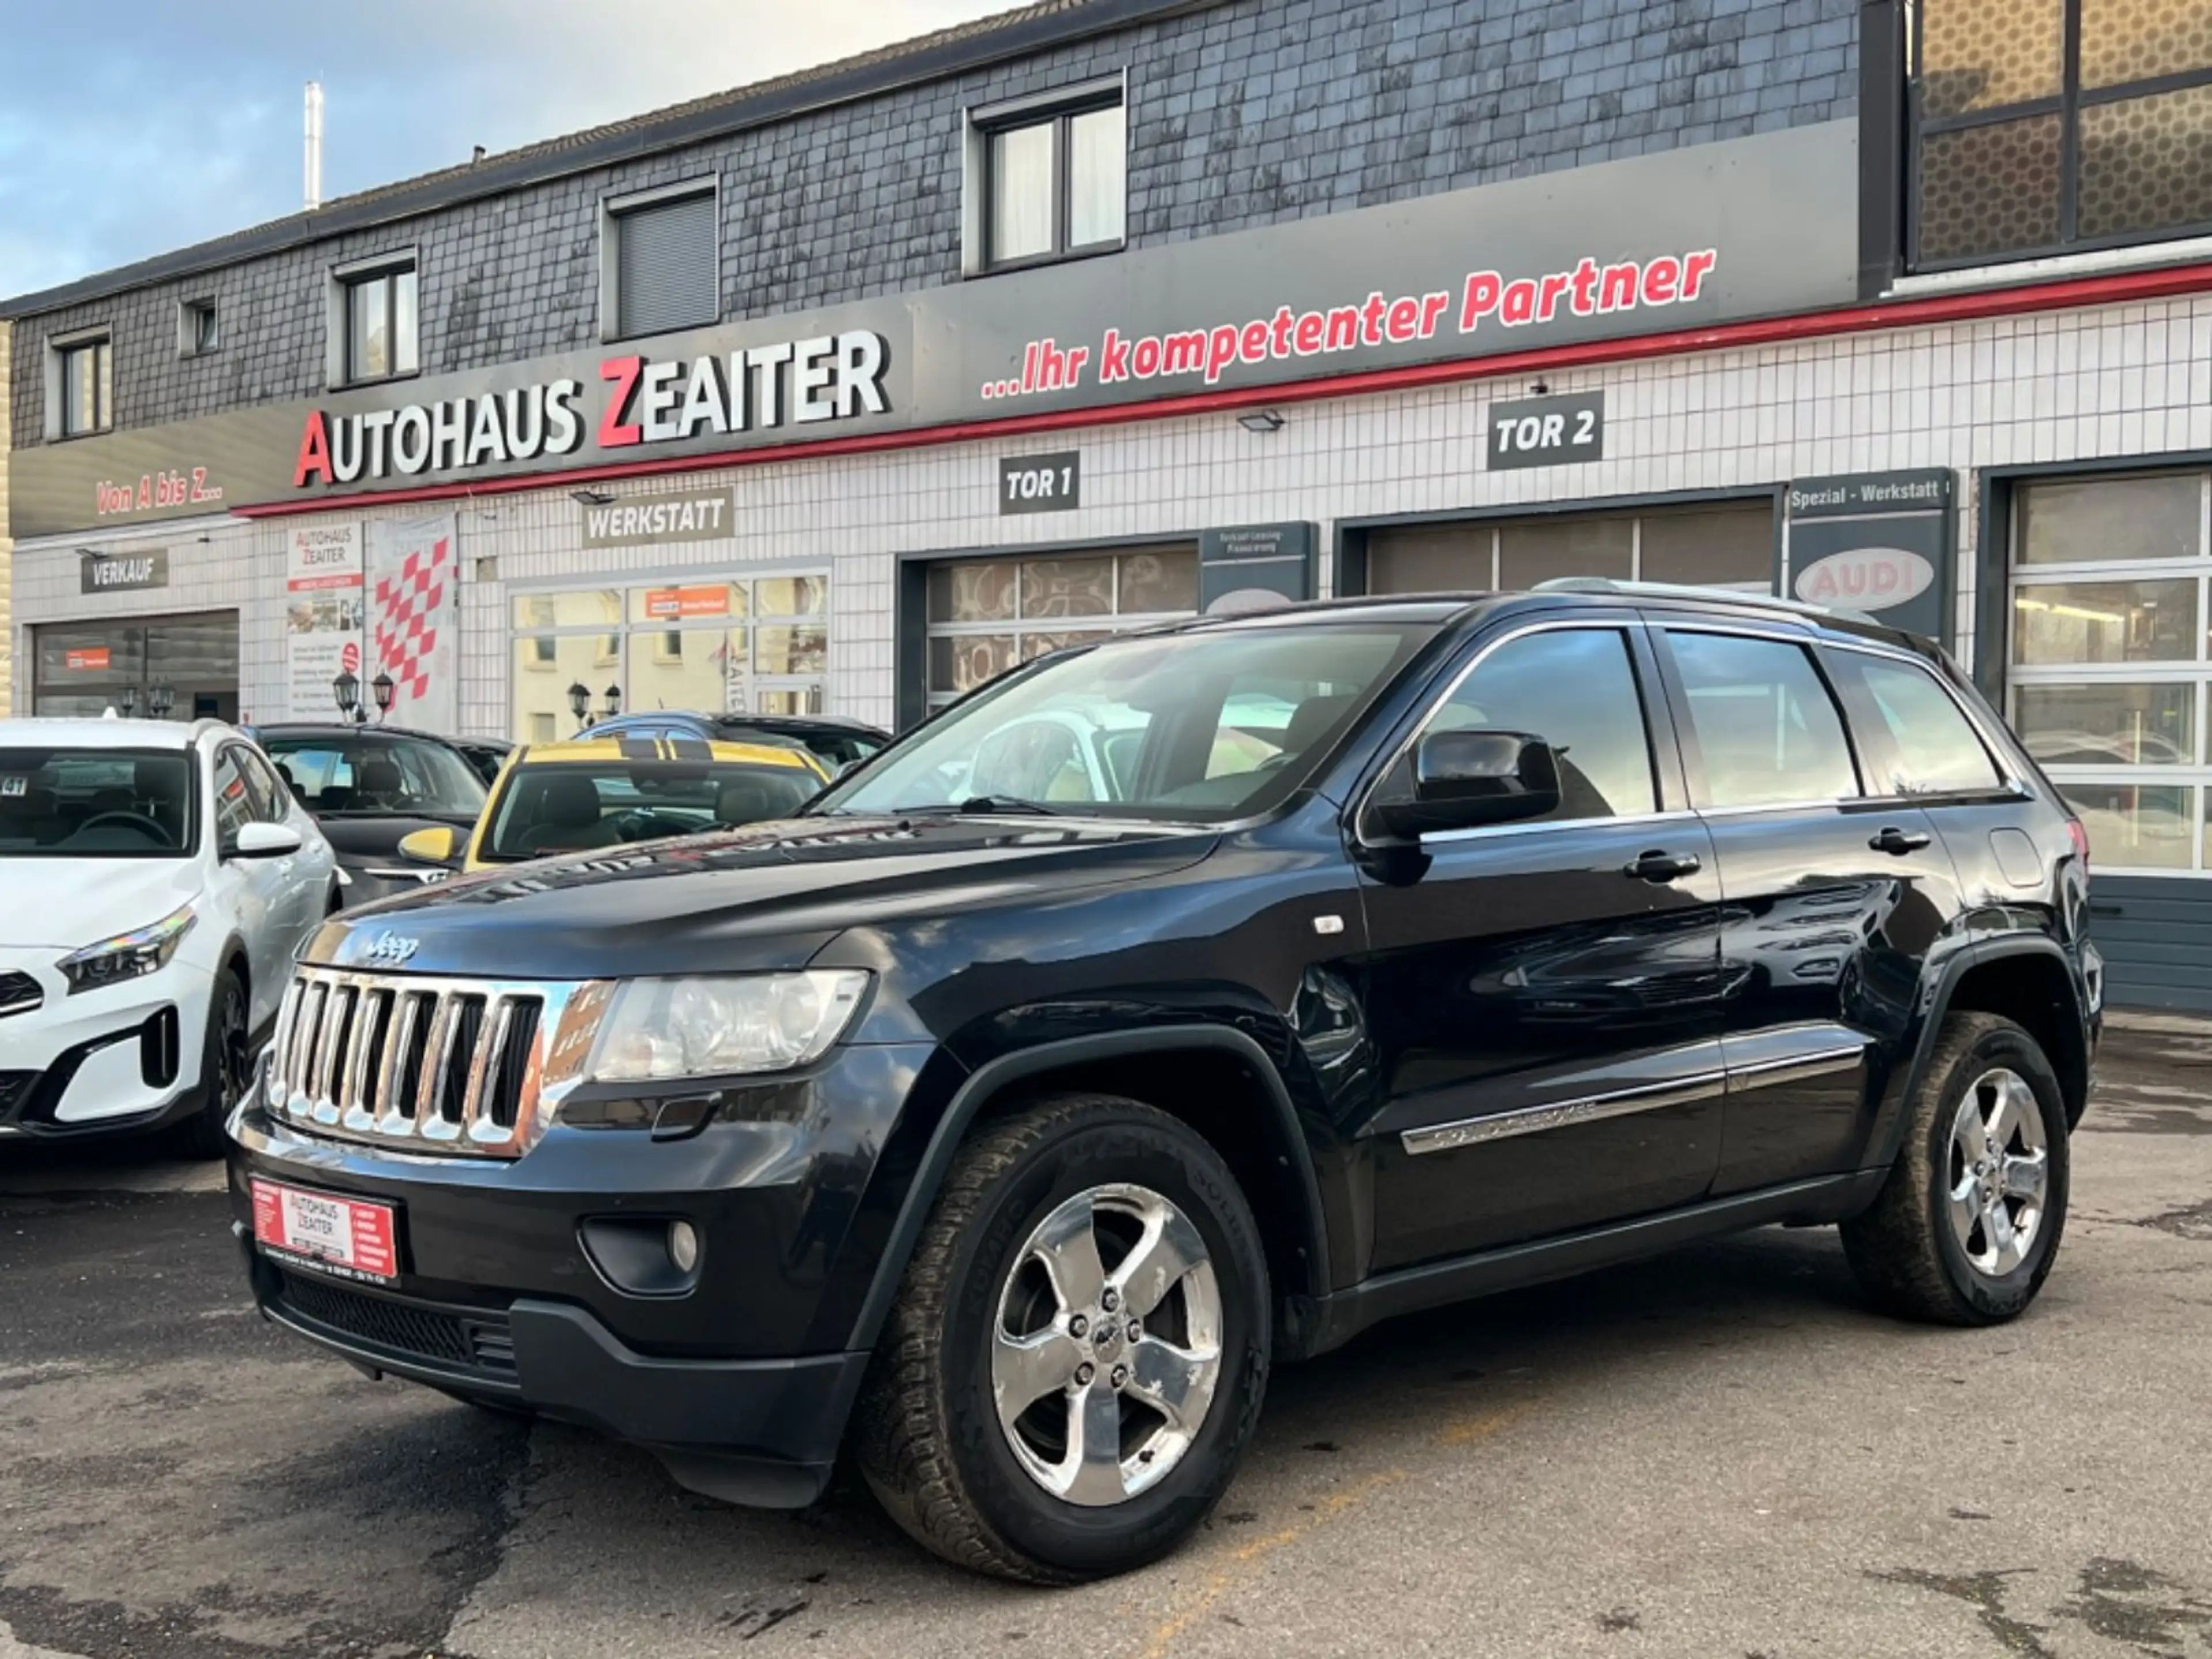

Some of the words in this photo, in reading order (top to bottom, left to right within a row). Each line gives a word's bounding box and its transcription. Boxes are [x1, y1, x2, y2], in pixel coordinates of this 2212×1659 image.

[1099, 291, 1449, 384] kompetenter
[1459, 248, 1717, 335] Partner
[293, 378, 579, 487] AUTOHAUS
[597, 329, 887, 448] ZEAITER
[1497, 413, 1565, 452] TOR
[1573, 410, 1594, 446] 2
[96, 480, 132, 514] Von
[135, 474, 151, 510] A
[156, 469, 187, 507] bis
[1006, 469, 1054, 500] TOR
[1061, 467, 1072, 495] 1
[1792, 487, 1846, 510] Spezial
[1861, 480, 1940, 503] Werkstatt
[586, 498, 725, 539] WERKSTATT
[296, 527, 353, 548] AUTOHAUS
[93, 557, 154, 586] VERKAUF
[303, 546, 346, 565] ZEAITER
[1810, 558, 1914, 598] AUDI
[366, 929, 420, 964] Jeep
[290, 1193, 339, 1220] AUTOHAUS
